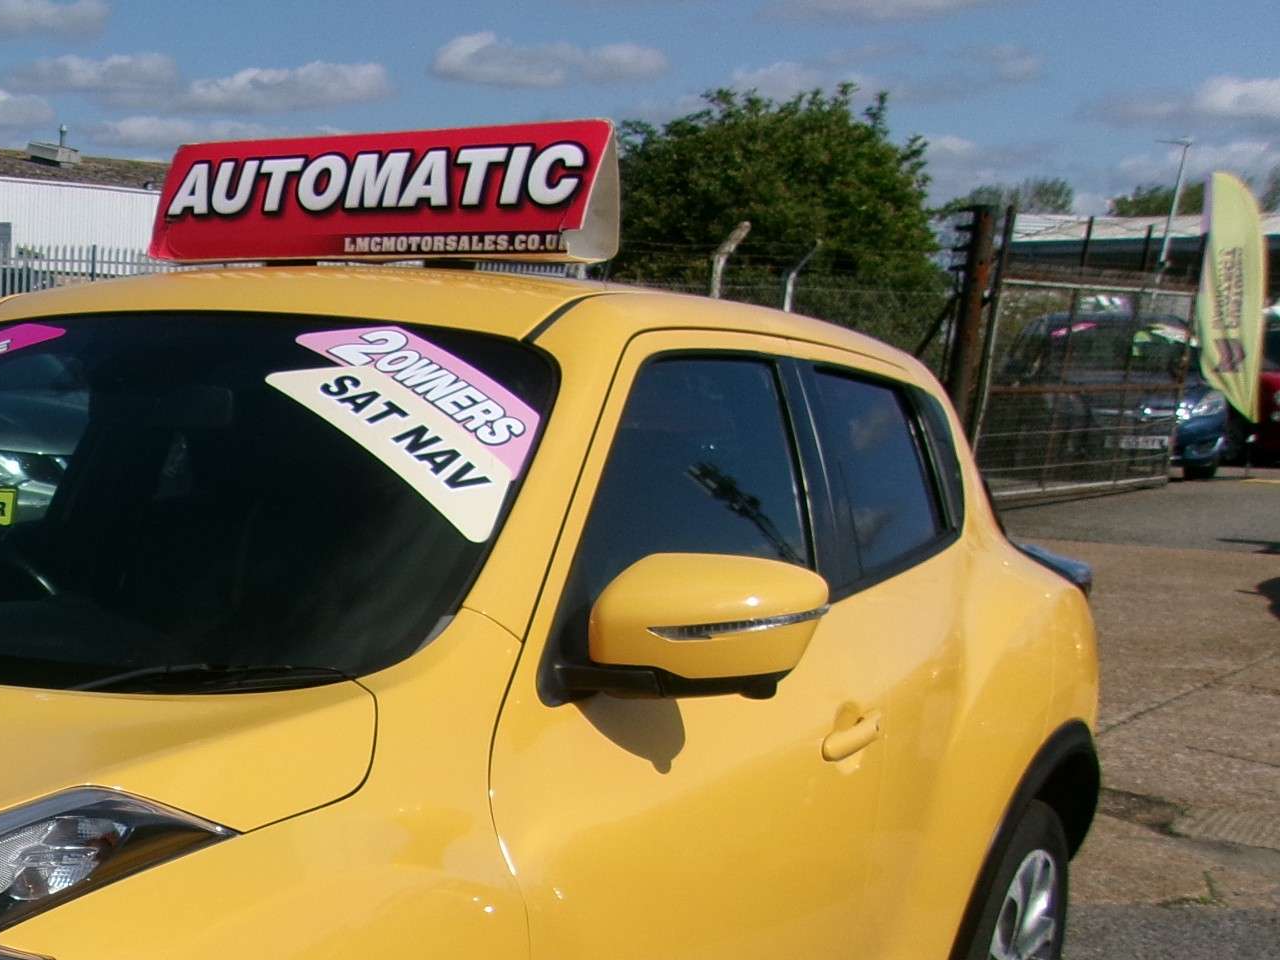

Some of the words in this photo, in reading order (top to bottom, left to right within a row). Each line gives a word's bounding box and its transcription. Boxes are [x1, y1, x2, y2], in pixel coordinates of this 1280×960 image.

[167, 141, 587, 217] AUTOMATIC
[319, 374, 410, 425] SAT
[391, 424, 493, 490] NAV
[327, 330, 408, 367] 2
[375, 350, 527, 446] OWNERS
